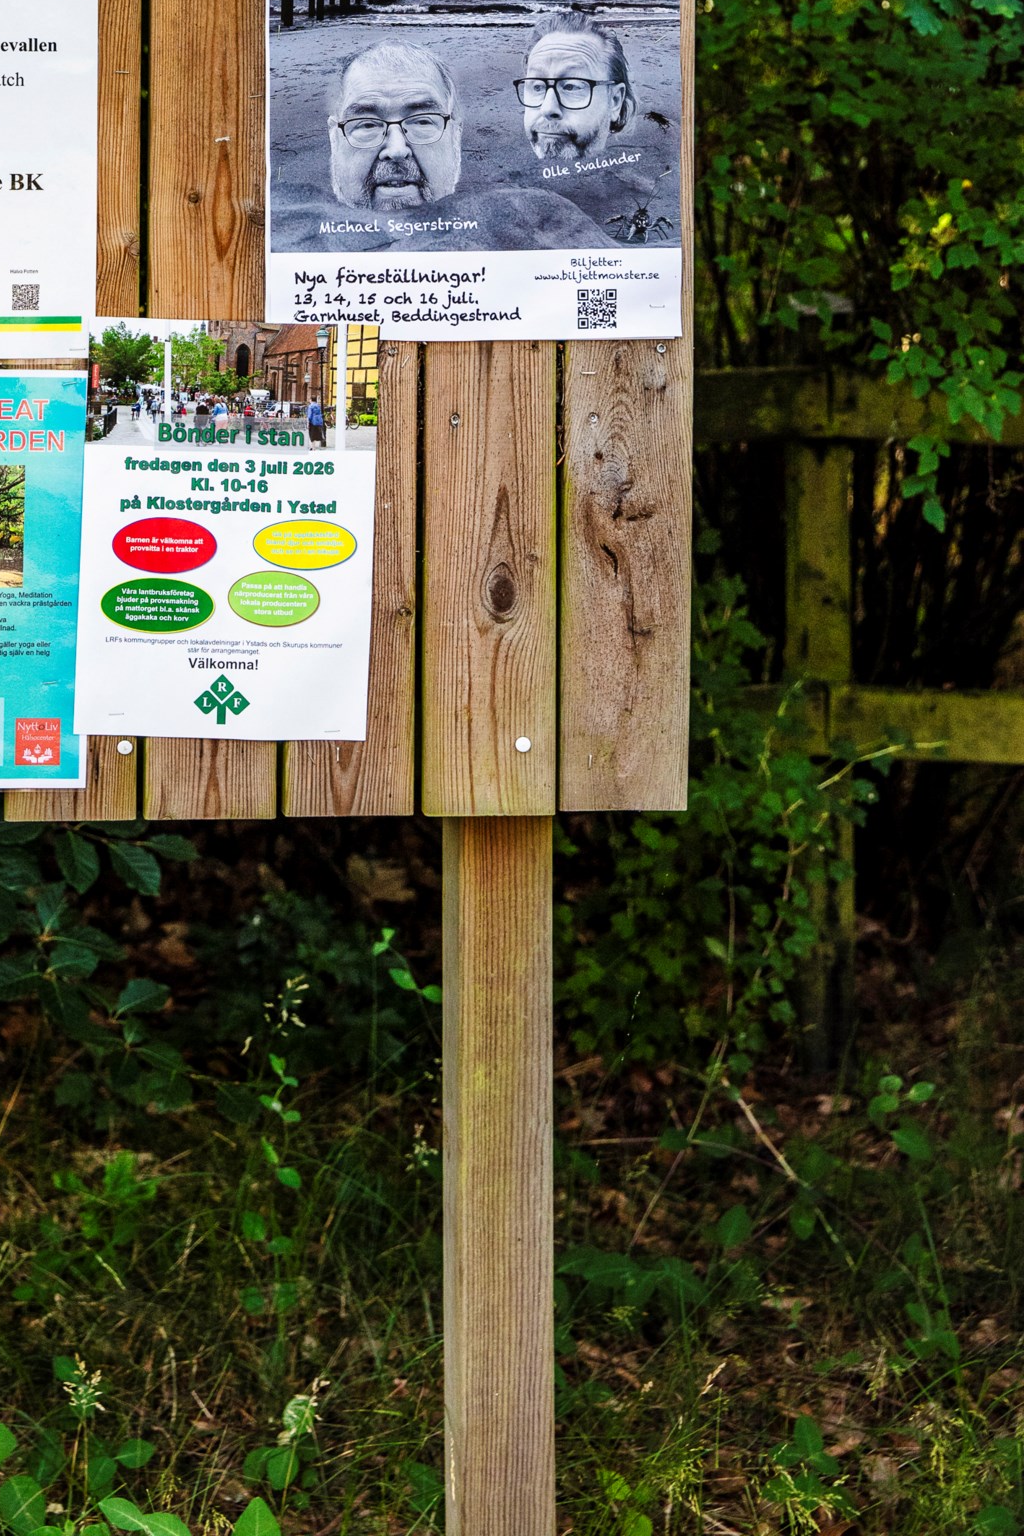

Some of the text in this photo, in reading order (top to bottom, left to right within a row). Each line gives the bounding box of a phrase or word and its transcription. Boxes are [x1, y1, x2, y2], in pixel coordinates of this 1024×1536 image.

[543, 153, 641, 178] Olle Svalander
[10, 174, 43, 190] BK
[319, 217, 477, 235] Michael Segerström
[571, 257, 621, 270] Biljetter:
[295, 267, 485, 288] Nya föreställningar!
[535, 269, 659, 283] www.biljettmonster.se
[295, 290, 478, 309] 13, 14, 15 och 16 juli.
[293, 306, 521, 324] Garnhuset, Beddingestrand
[158, 422, 305, 446] Bönder i stan
[125, 457, 334, 476] fredagen den 3 juli 2026
[191, 478, 268, 493] Kl. 10-16
[120, 495, 141, 512] på
[147, 496, 271, 514] Klostergården
[287, 500, 336, 514] Ystad
[189, 658, 258, 670] Välkomna!
